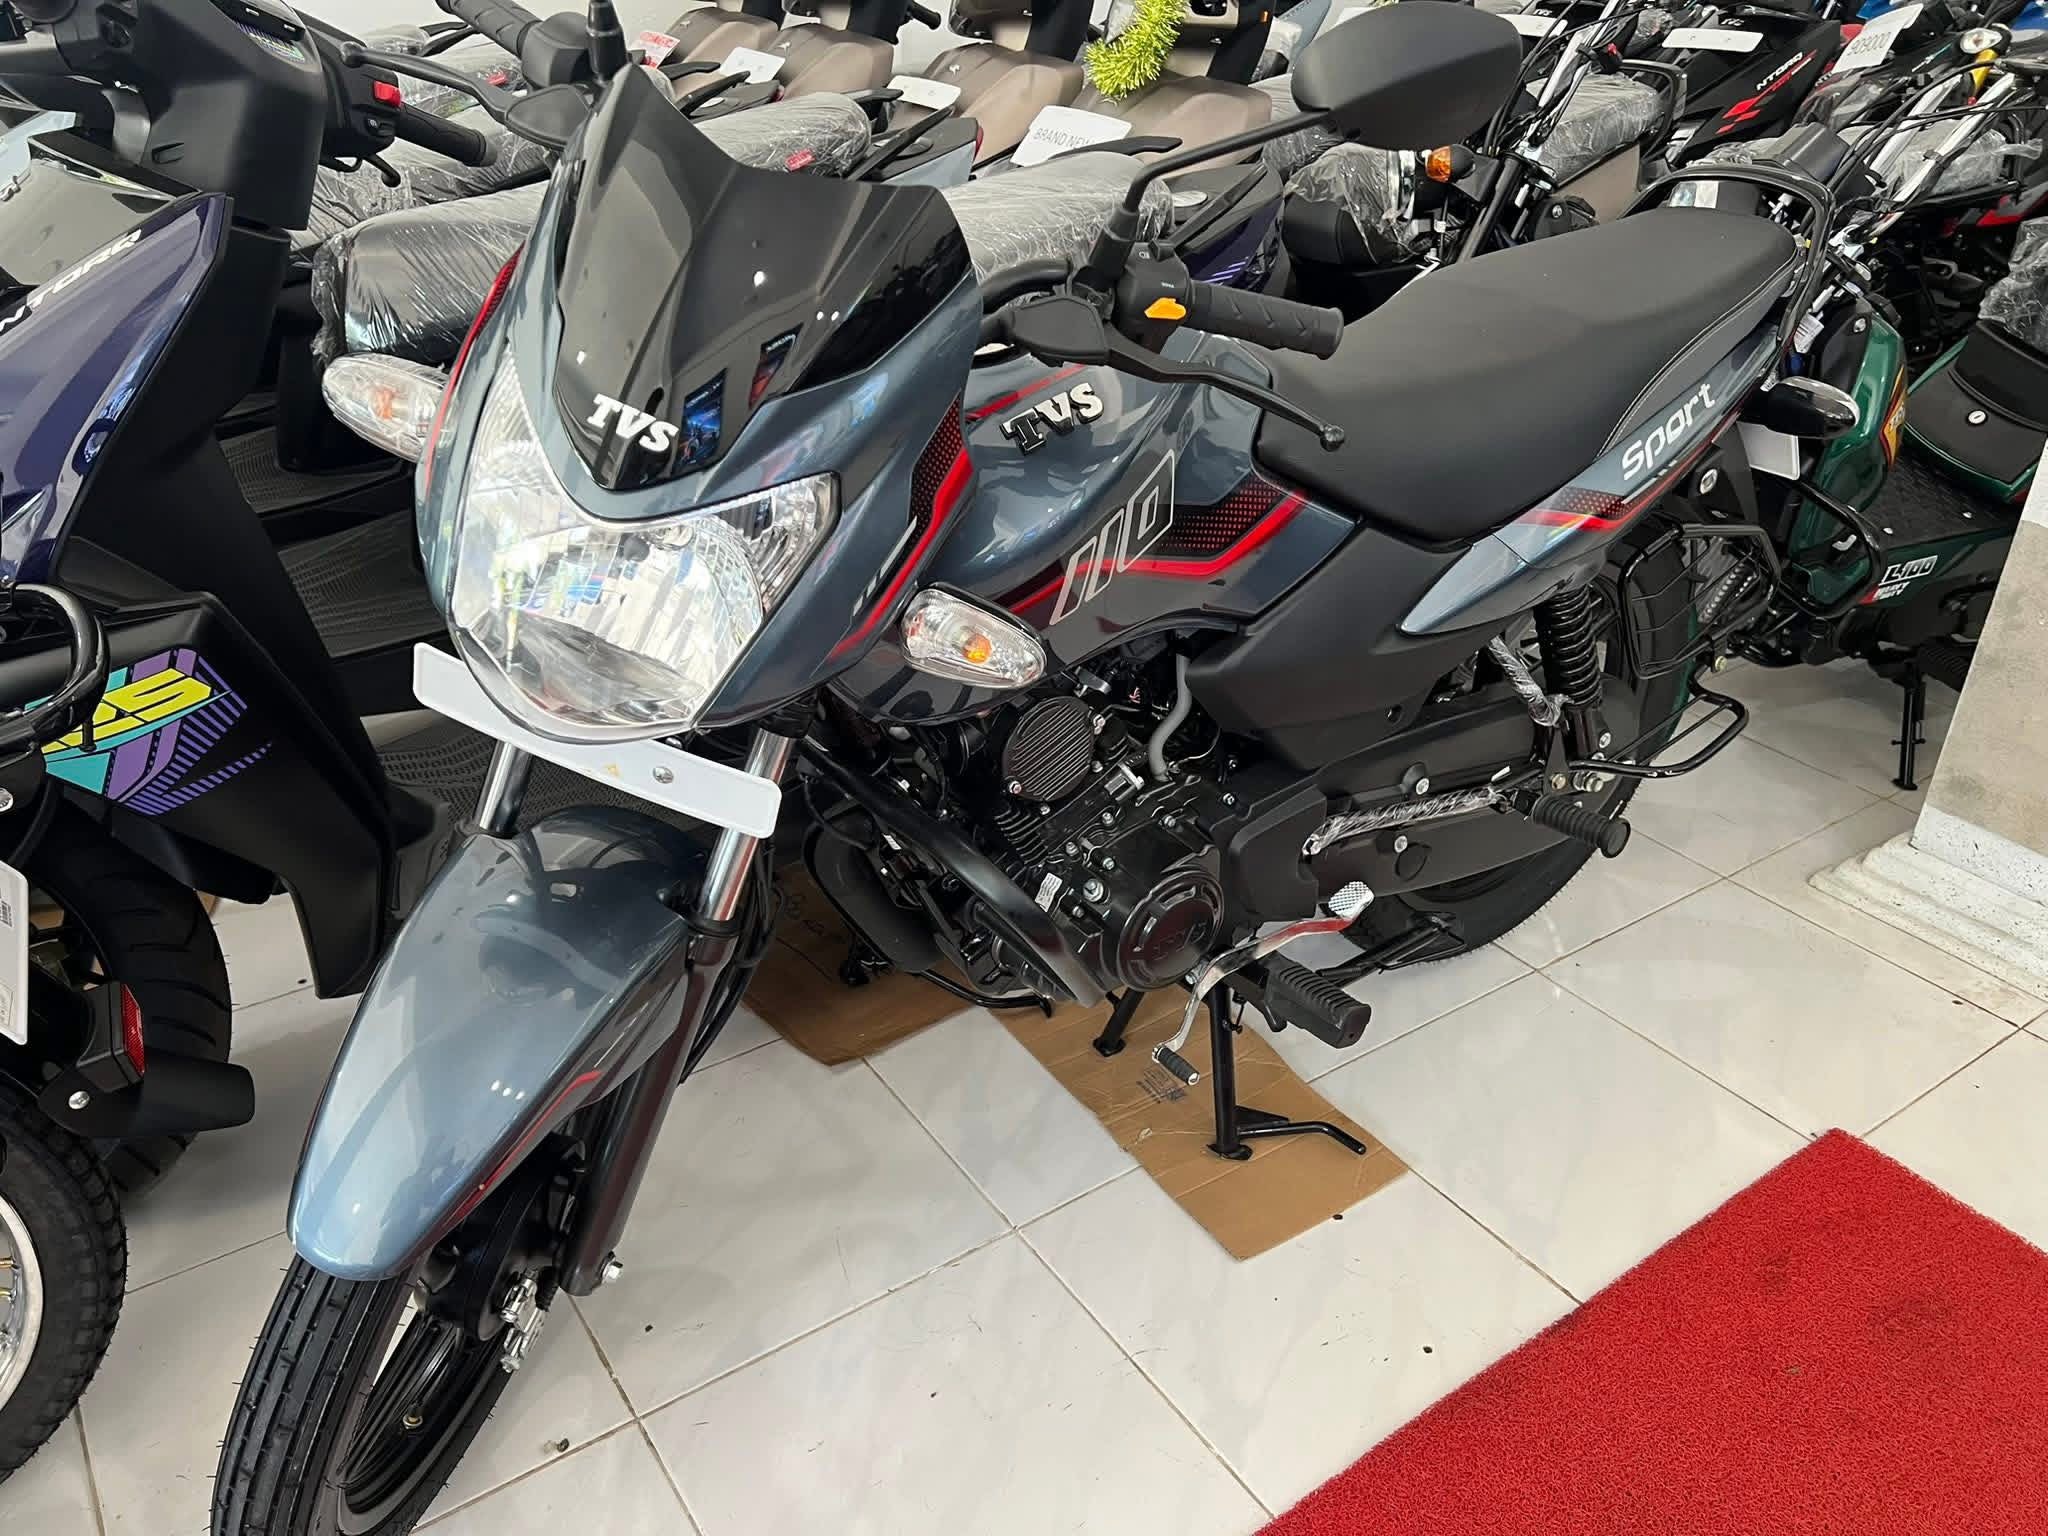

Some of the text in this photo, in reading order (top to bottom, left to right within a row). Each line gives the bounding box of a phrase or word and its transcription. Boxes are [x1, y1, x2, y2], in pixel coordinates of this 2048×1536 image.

[1756, 52, 1803, 90] NTORQ
[1033, 127, 1067, 146] BRAND
[587, 393, 679, 452] TVS
[1000, 382, 1104, 455] TVS
[1622, 383, 1716, 481] Sport
[1049, 449, 1175, 626] 110
